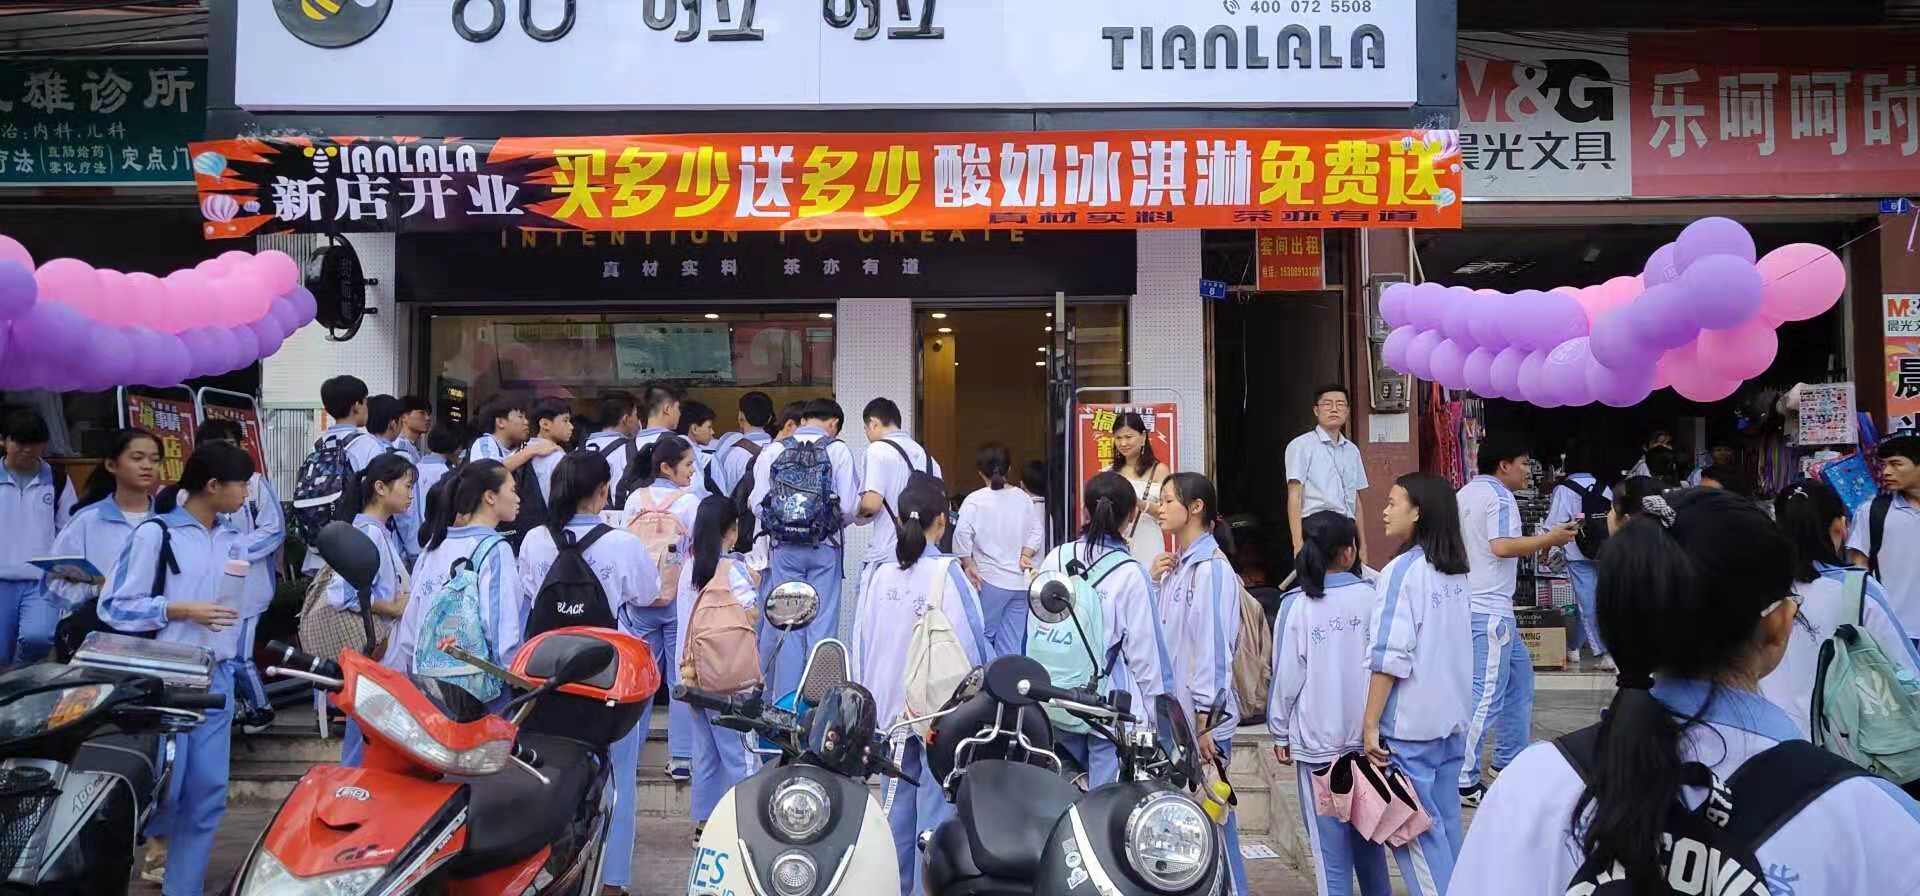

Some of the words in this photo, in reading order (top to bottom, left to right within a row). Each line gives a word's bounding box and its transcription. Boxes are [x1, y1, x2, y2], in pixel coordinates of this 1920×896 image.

[1251, 0, 1280, 13] 400
[1291, 0, 1320, 13] 072
[1331, 0, 1372, 13] 5508
[1102, 24, 1385, 70] TIANLALA
[0, 67, 195, 113] 雄诊所
[1459, 130, 1616, 170] 晨光文具
[271, 174, 525, 221] 新店开业
[602, 259, 738, 279] 真材实料
[783, 257, 921, 276] 茶亦有道
[557, 602, 584, 615] BLACK
[1034, 629, 1073, 645] FILA
